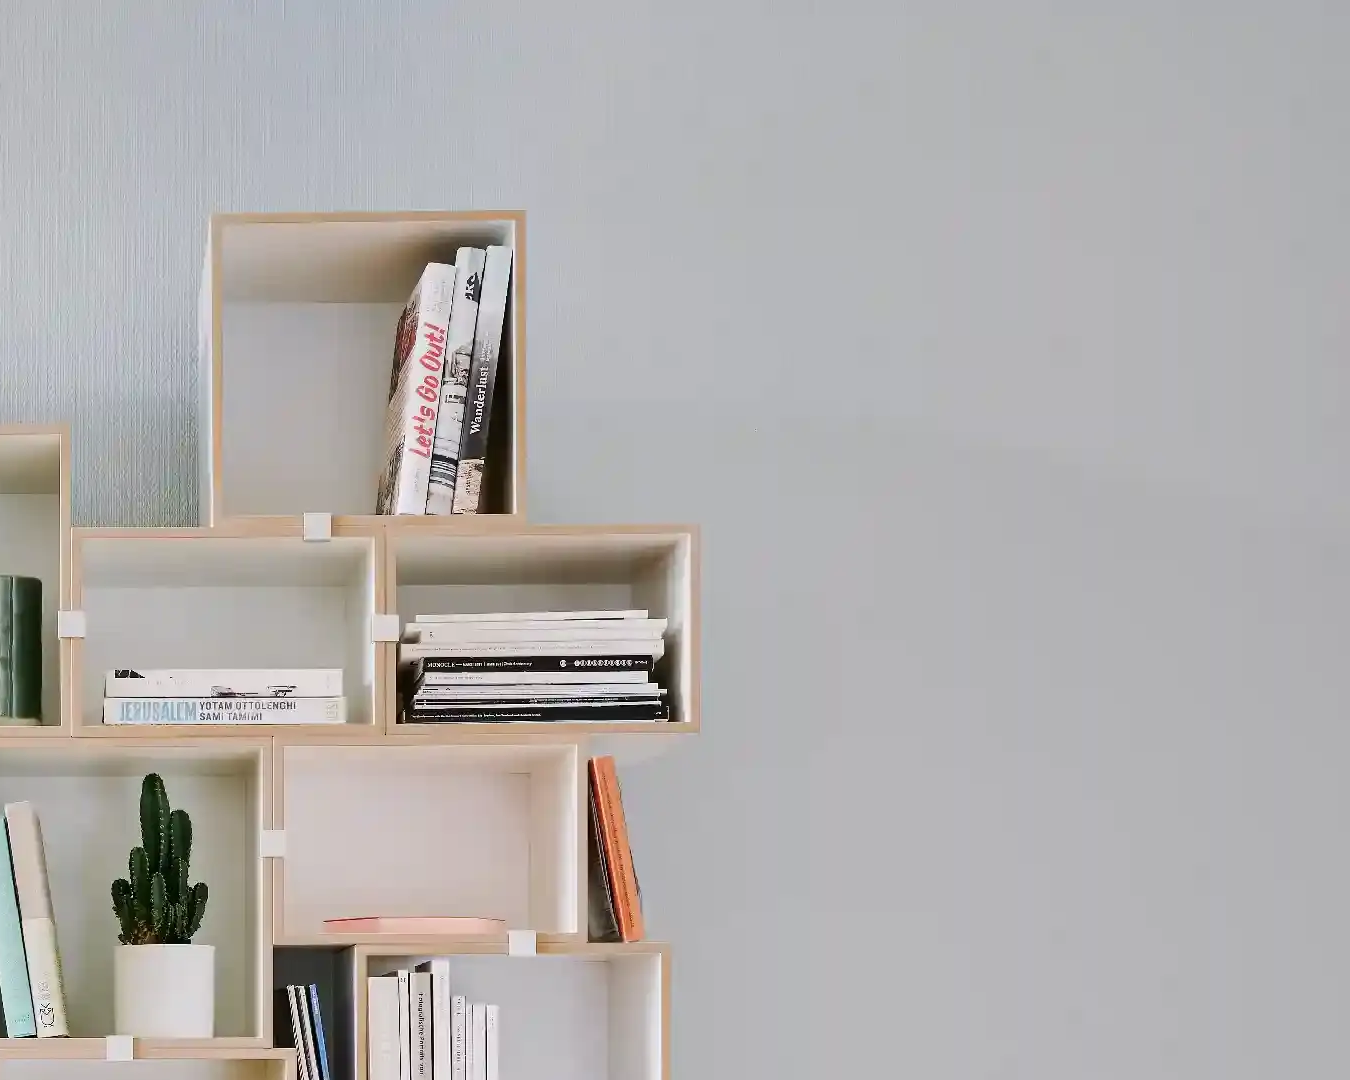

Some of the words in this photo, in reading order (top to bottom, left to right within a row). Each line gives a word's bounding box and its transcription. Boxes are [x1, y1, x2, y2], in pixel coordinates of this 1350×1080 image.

[418, 321, 446, 373] Out!
[415, 375, 439, 402] Go
[470, 366, 489, 436] Wanderlust
[408, 402, 436, 459] Let's
[119, 701, 197, 721] JERUSALEM
[199, 701, 232, 710] YOTAM
[236, 701, 297, 710] OTTOLENGHI
[199, 713, 224, 721] SAMI
[227, 712, 263, 721] TAMIMI
